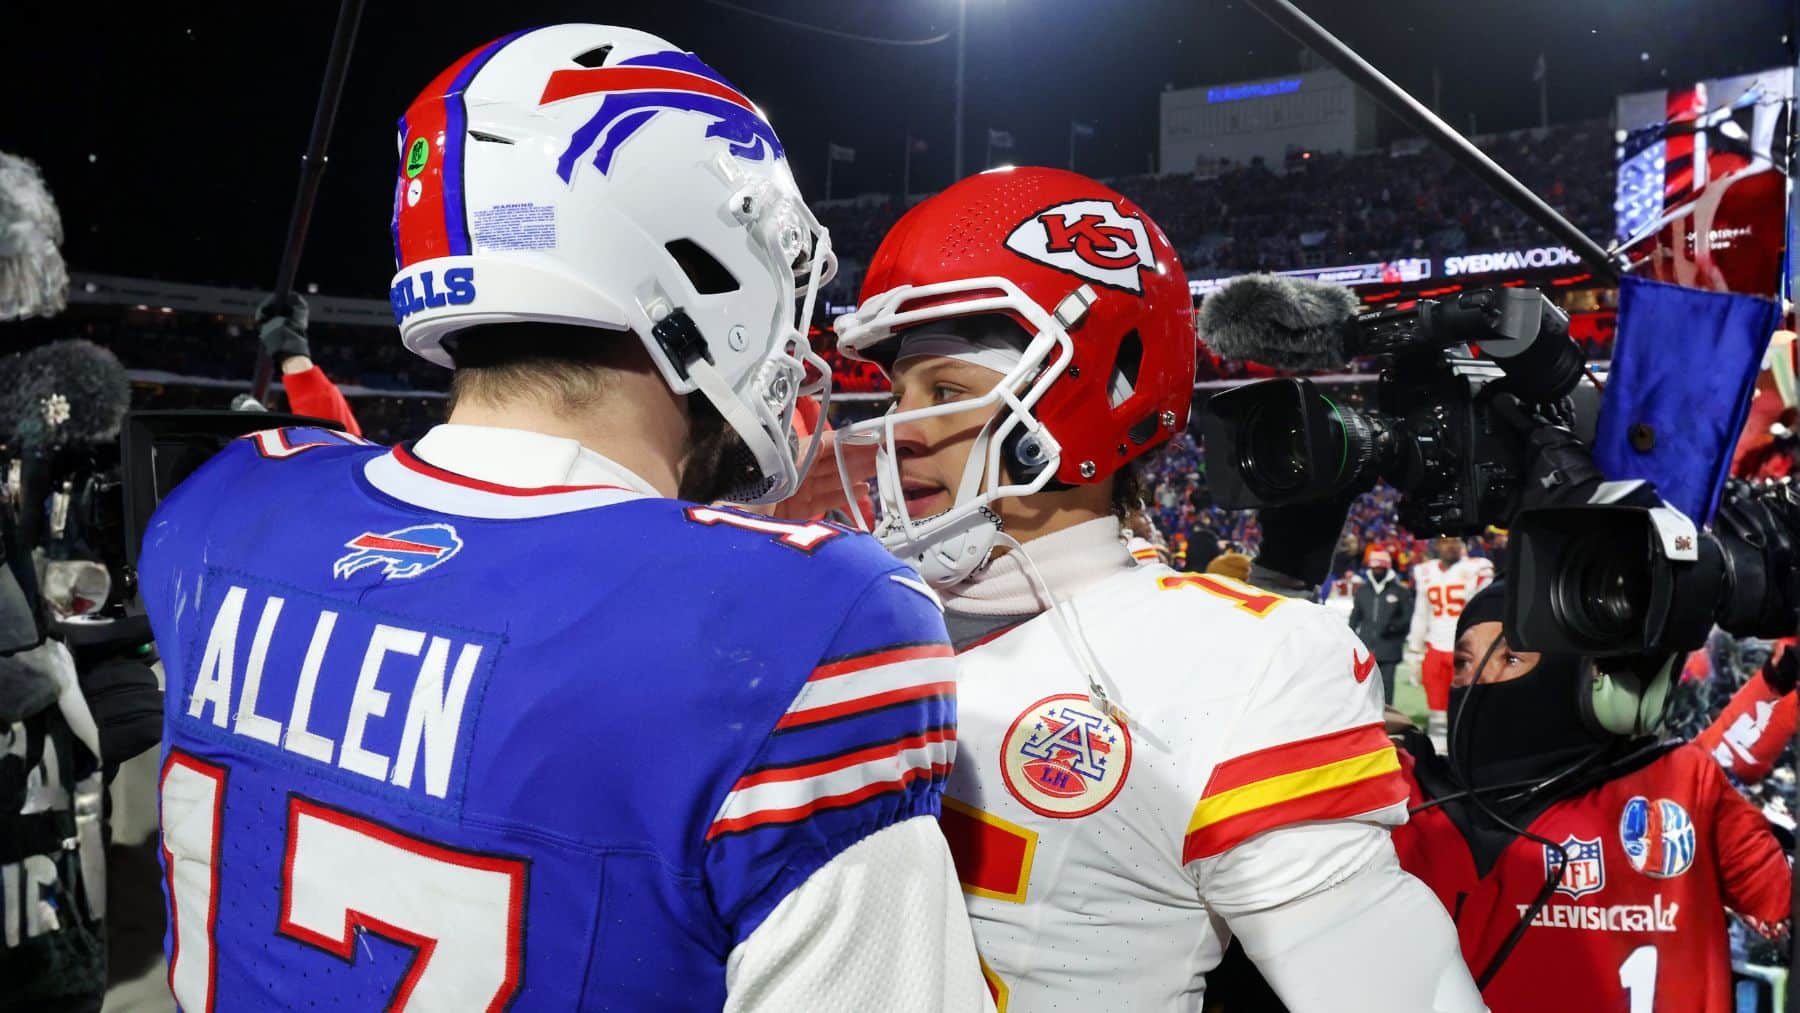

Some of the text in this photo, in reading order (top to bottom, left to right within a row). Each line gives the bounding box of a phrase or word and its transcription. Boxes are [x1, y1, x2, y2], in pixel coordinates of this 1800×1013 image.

[1037, 213, 1141, 270] KC
[1427, 584, 1466, 616] 95
[187, 585, 483, 799] ALLEN
[159, 744, 533, 1013] 17
[1618, 944, 1658, 1013] 1
